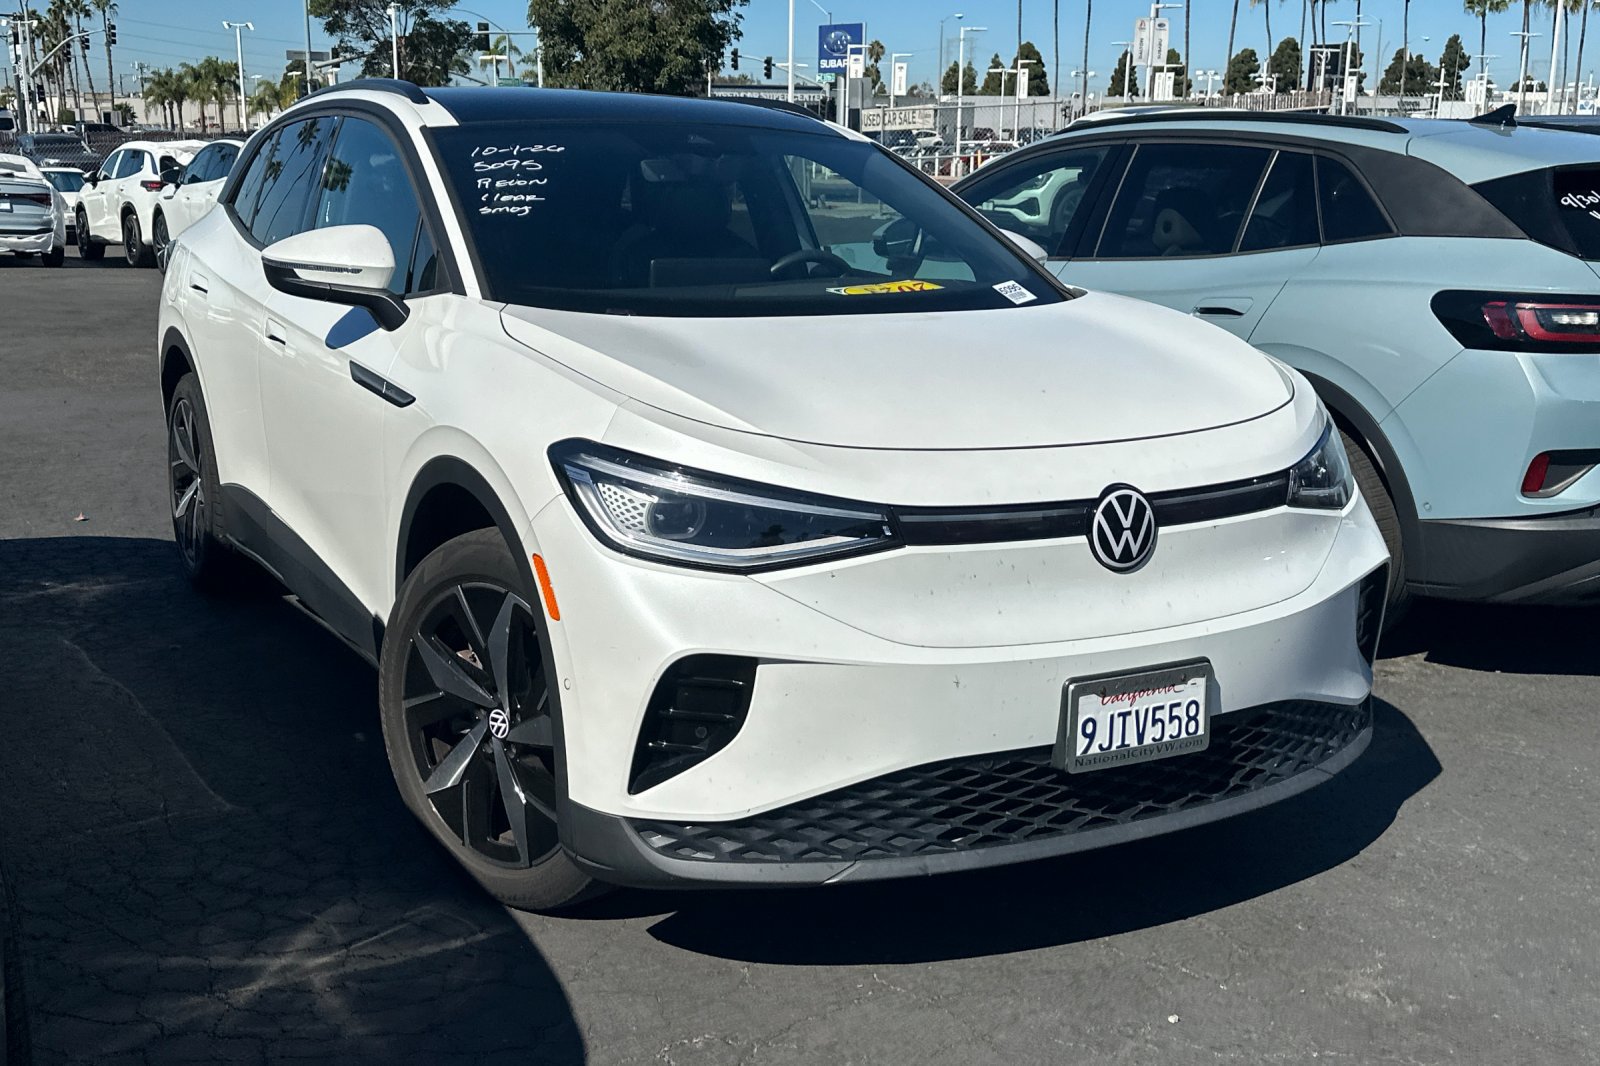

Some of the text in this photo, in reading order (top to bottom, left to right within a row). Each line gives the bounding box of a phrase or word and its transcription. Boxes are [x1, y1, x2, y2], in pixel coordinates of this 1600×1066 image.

[820, 59, 848, 68] SUBAR
[863, 113, 881, 127] USED
[883, 111, 897, 126] CAR
[898, 110, 917, 125] SALE
[1079, 699, 1200, 756] 9JIV558
